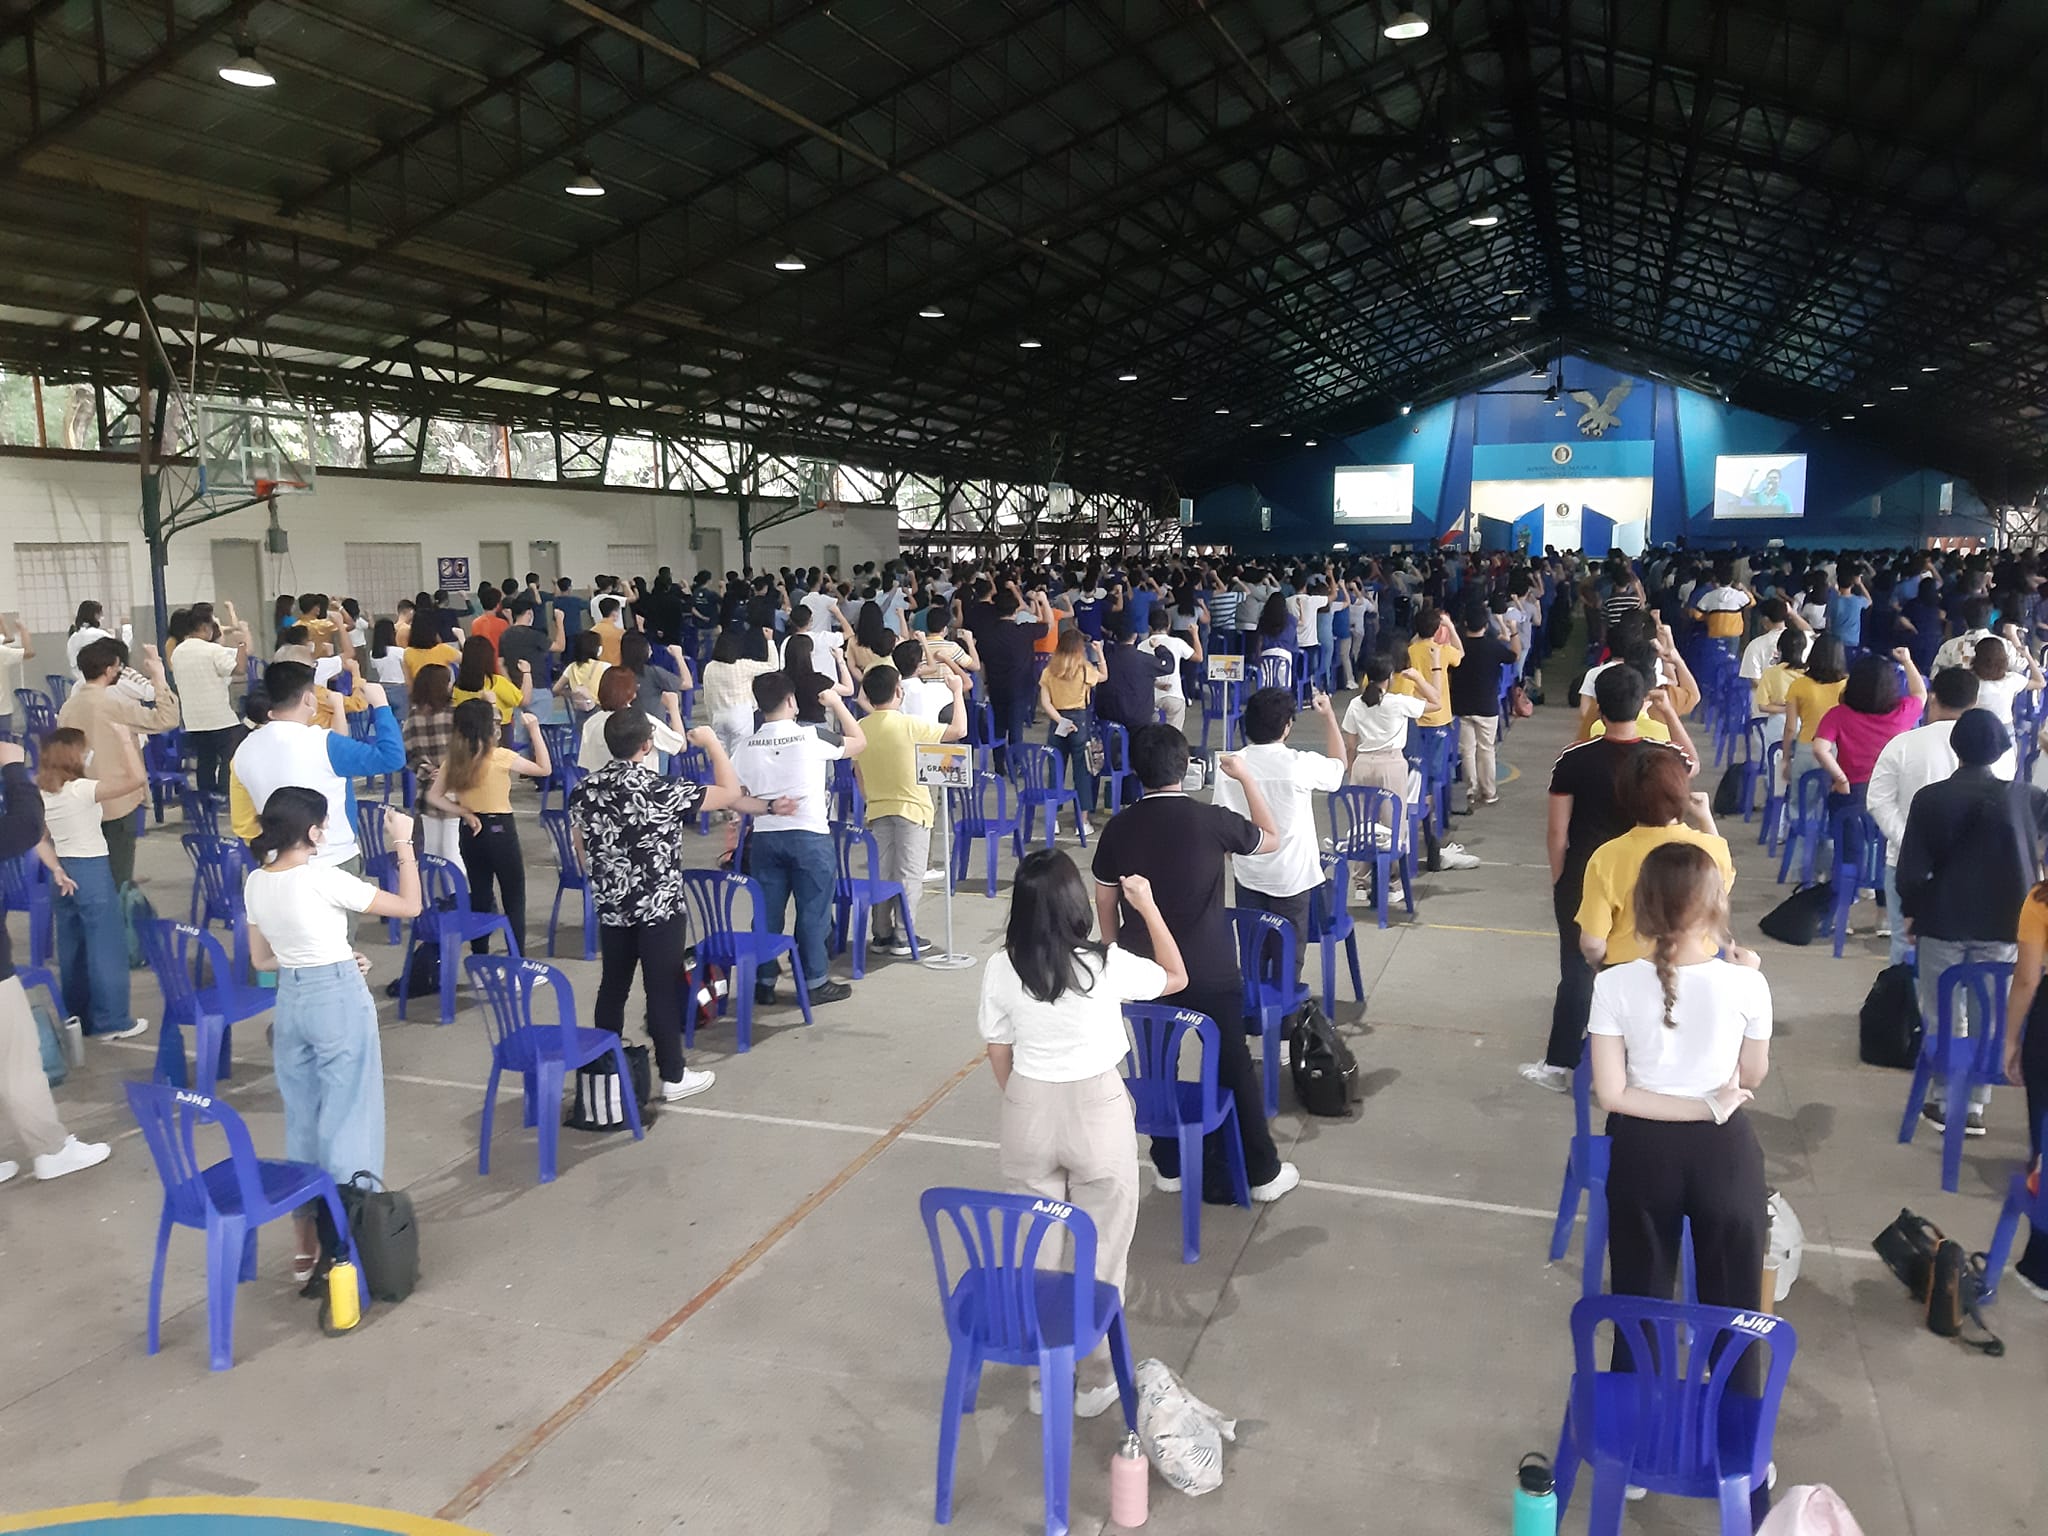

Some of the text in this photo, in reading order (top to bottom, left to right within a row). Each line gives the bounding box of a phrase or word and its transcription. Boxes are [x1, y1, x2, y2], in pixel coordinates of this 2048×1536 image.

[1260, 914, 1283, 927] AJHS
[521, 961, 549, 975] AJHS
[1175, 1011, 1203, 1026] AJHS
[175, 1091, 211, 1108] AJHS
[1032, 1200, 1072, 1219] AJHS
[1731, 1314, 1776, 1335] AJHS
